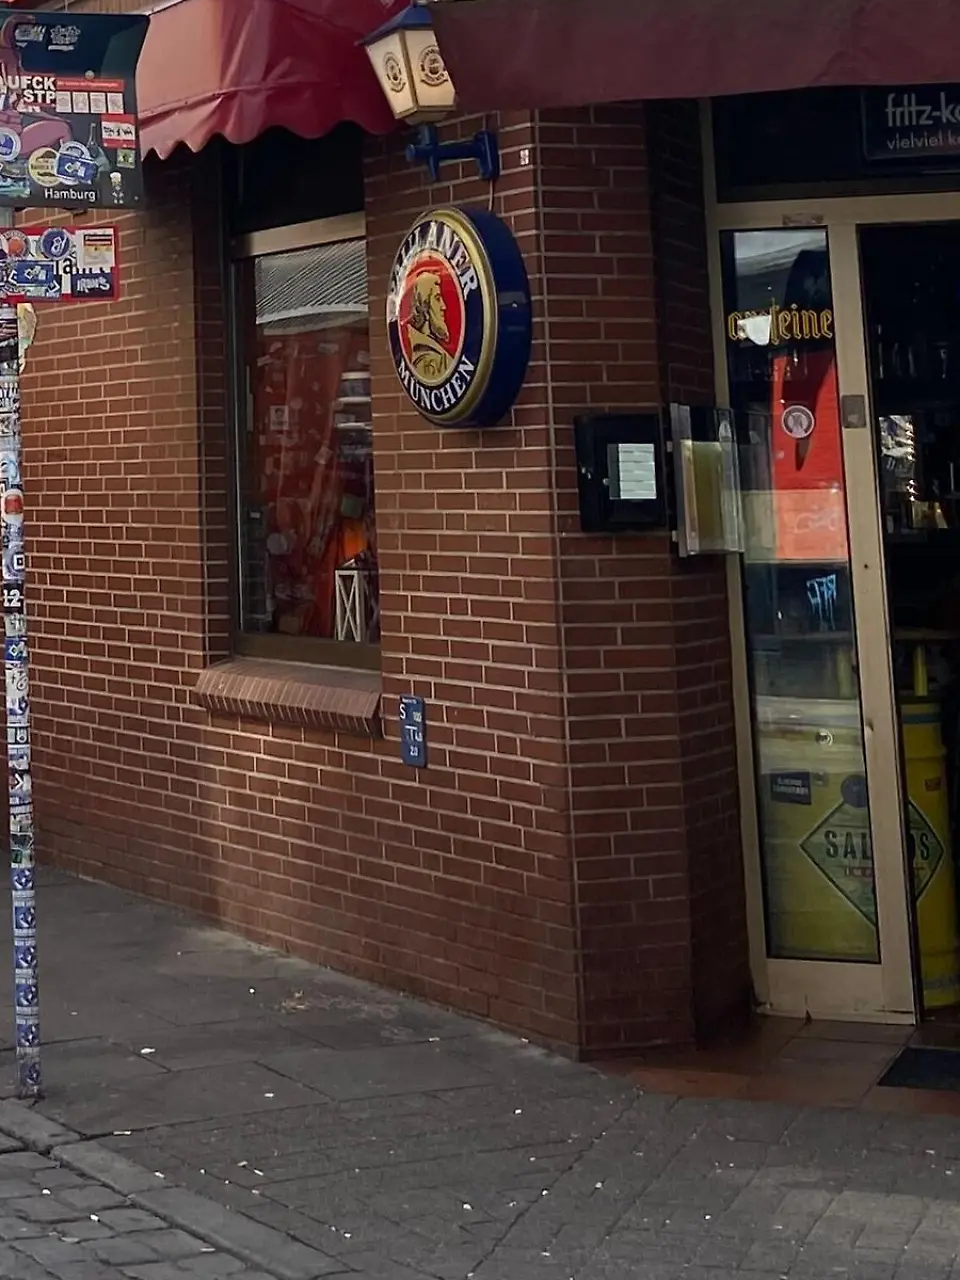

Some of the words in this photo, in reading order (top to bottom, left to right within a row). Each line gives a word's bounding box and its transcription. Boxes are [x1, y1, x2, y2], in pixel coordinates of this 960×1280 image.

[21, 76, 57, 91] FCK
[24, 90, 56, 104] STP
[44, 187, 96, 202] Hamburg
[398, 355, 476, 412] MÜNCHEN
[824, 829, 931, 861] SALS
